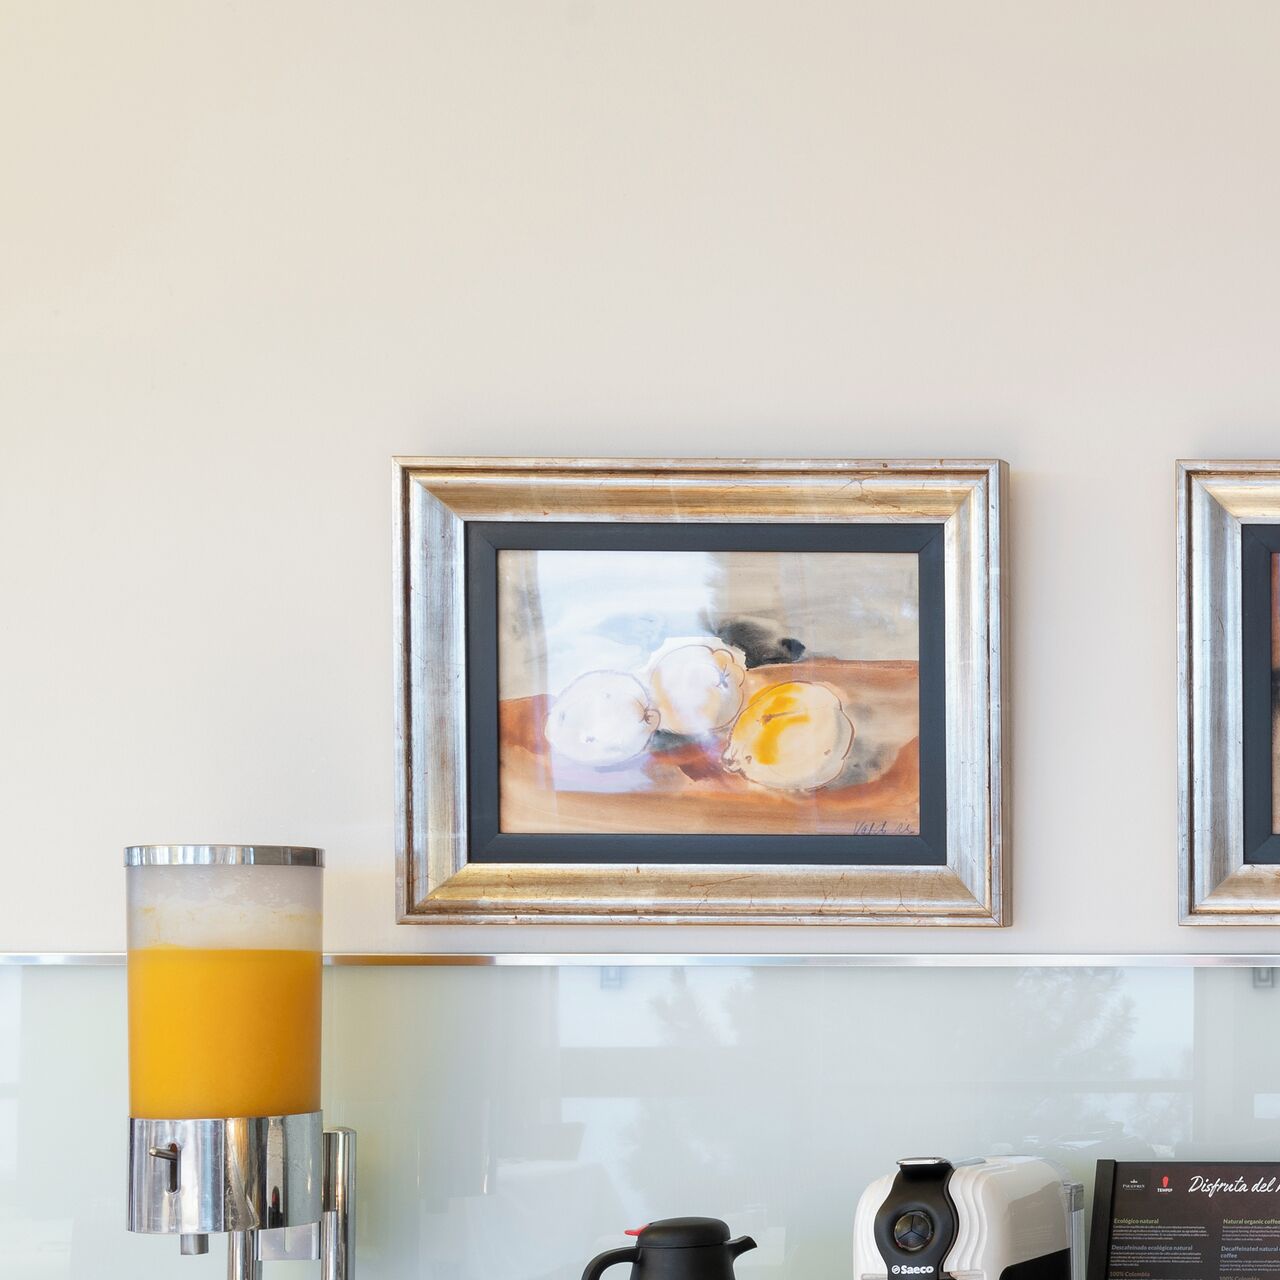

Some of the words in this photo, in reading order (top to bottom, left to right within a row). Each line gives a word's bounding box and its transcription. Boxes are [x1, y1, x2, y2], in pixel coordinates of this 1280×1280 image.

[1188, 1175, 1248, 1198] Disfruta
[1251, 1177, 1276, 1193] del
[901, 1265, 934, 1274] Saeco
